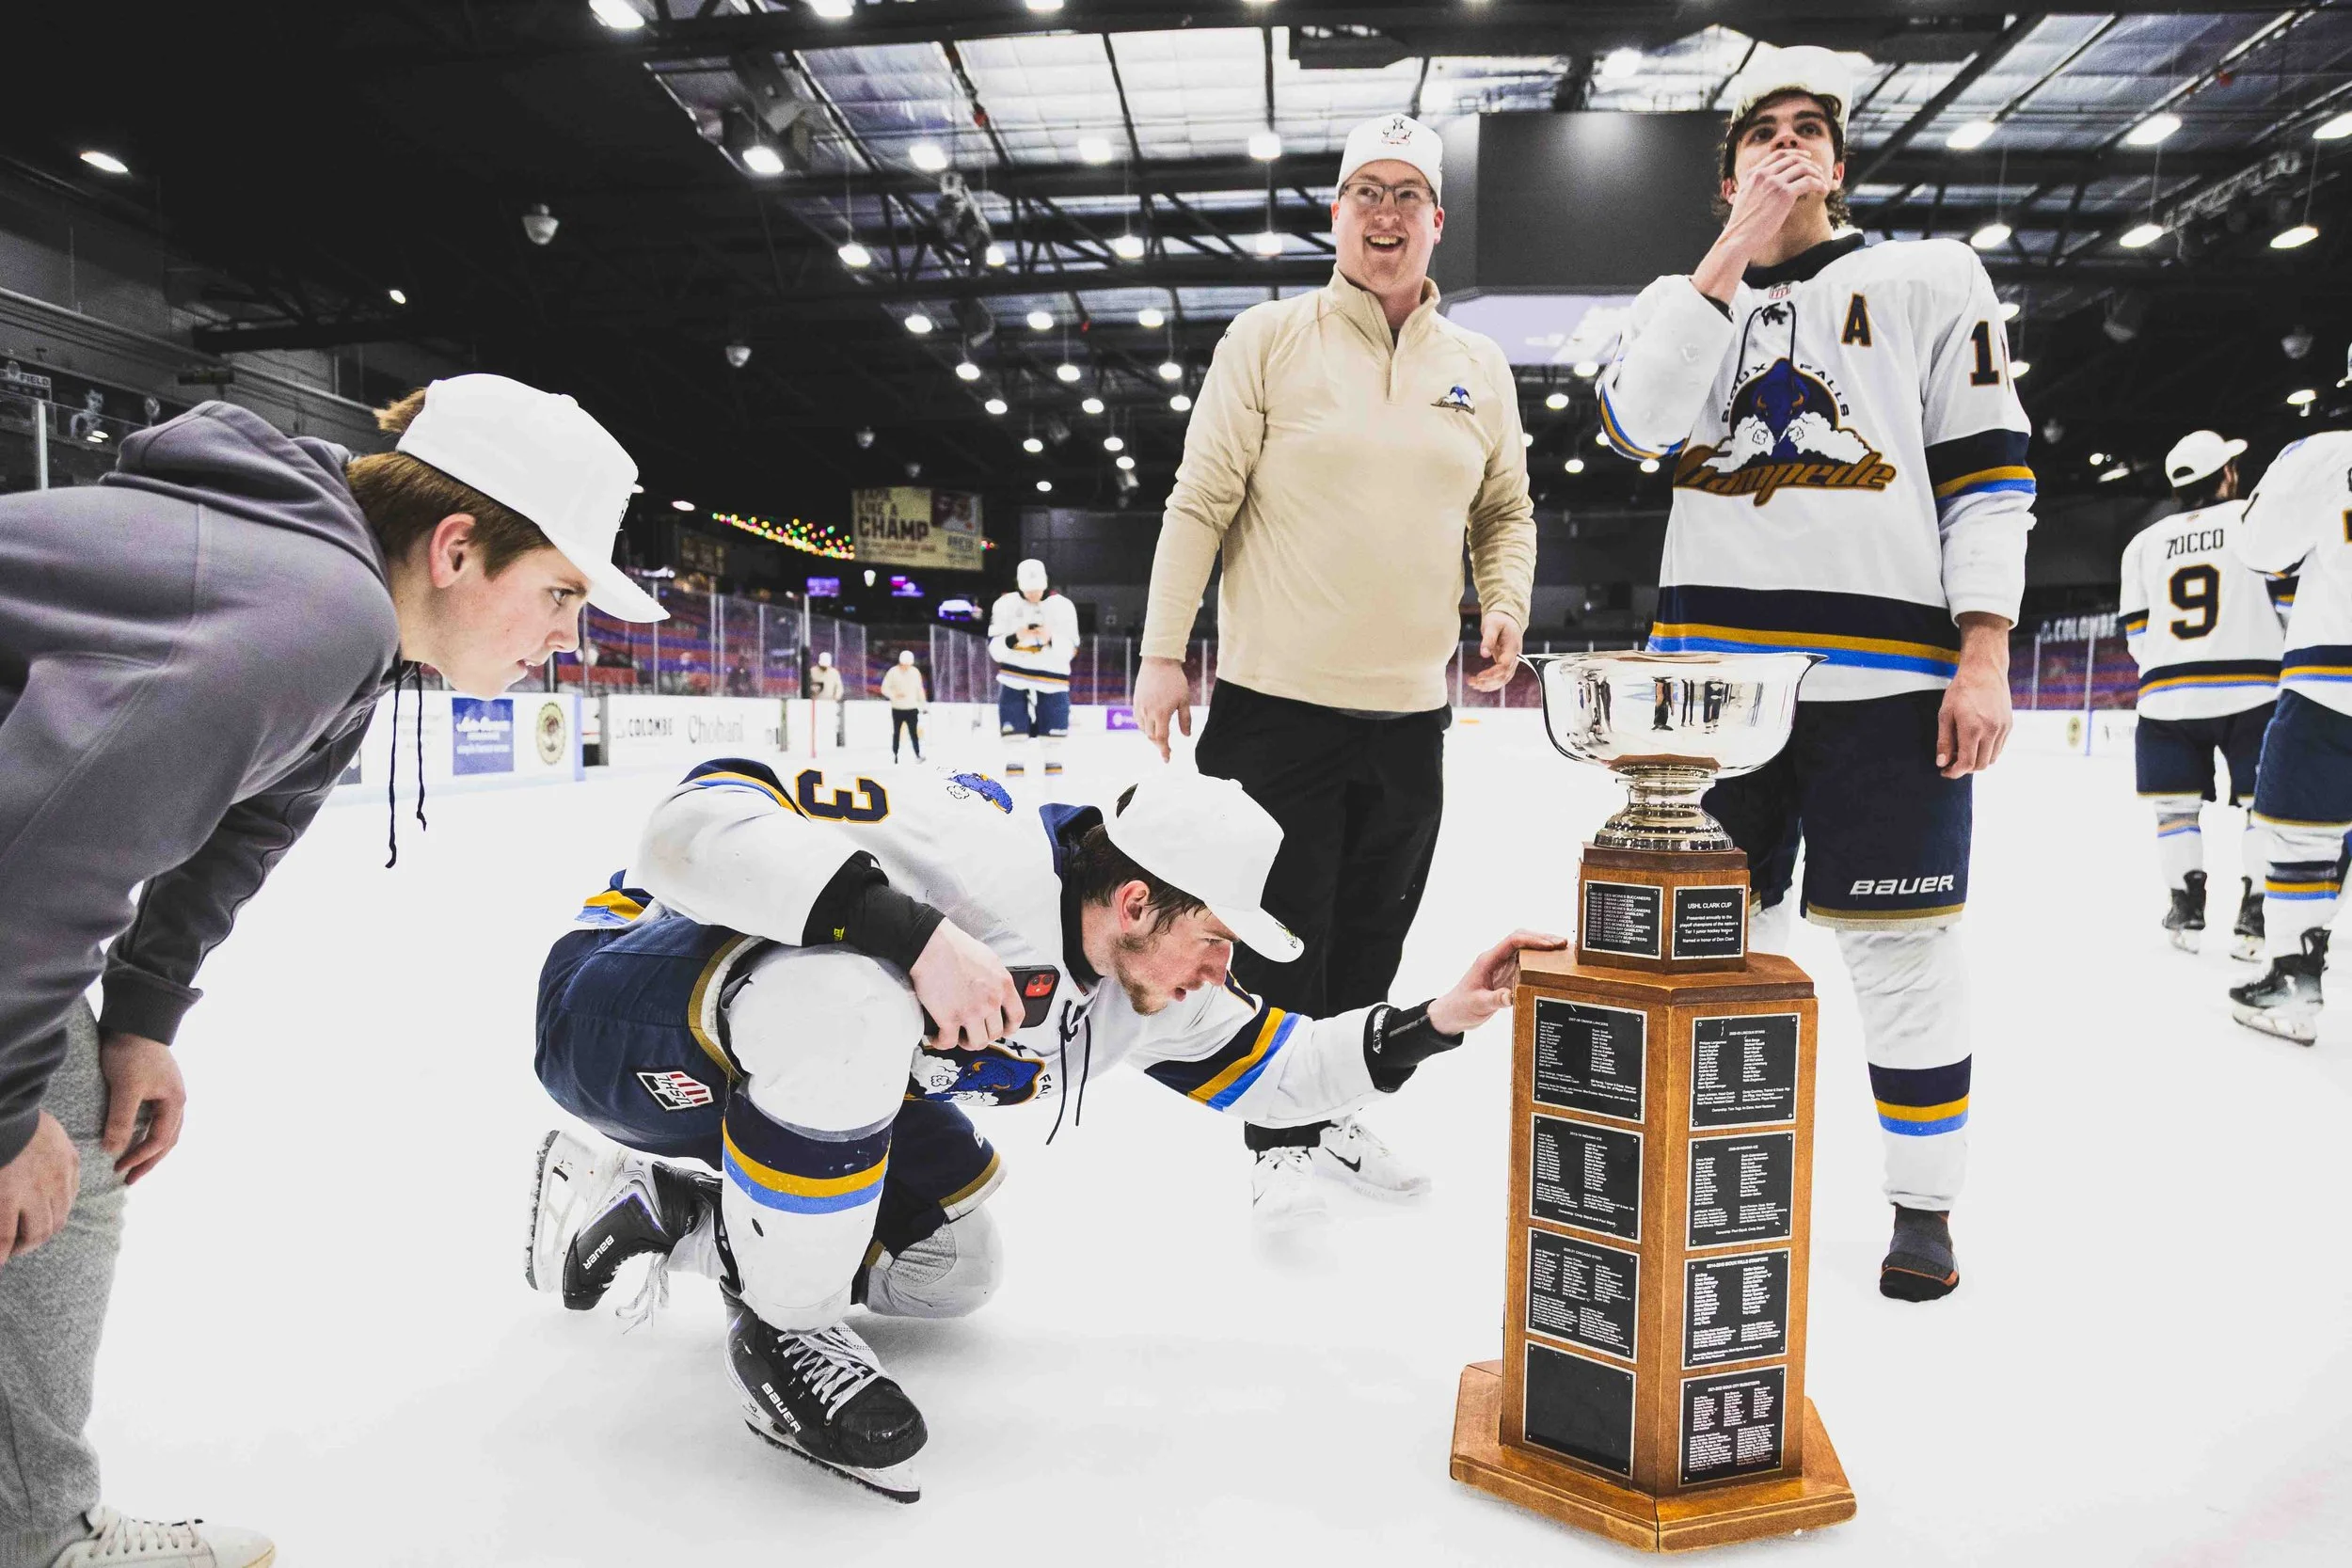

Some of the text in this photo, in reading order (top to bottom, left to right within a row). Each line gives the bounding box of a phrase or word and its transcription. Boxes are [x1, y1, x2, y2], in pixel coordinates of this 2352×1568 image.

[1841, 293, 1872, 347] A
[858, 516, 930, 541] CHAMP
[2167, 529, 2224, 560] ZOCCO
[2169, 563, 2220, 641] 9
[629, 716, 673, 737] COLOMBE
[688, 714, 744, 744] Chobani
[795, 768, 890, 823] 3
[659, 1075, 692, 1105] USHL
